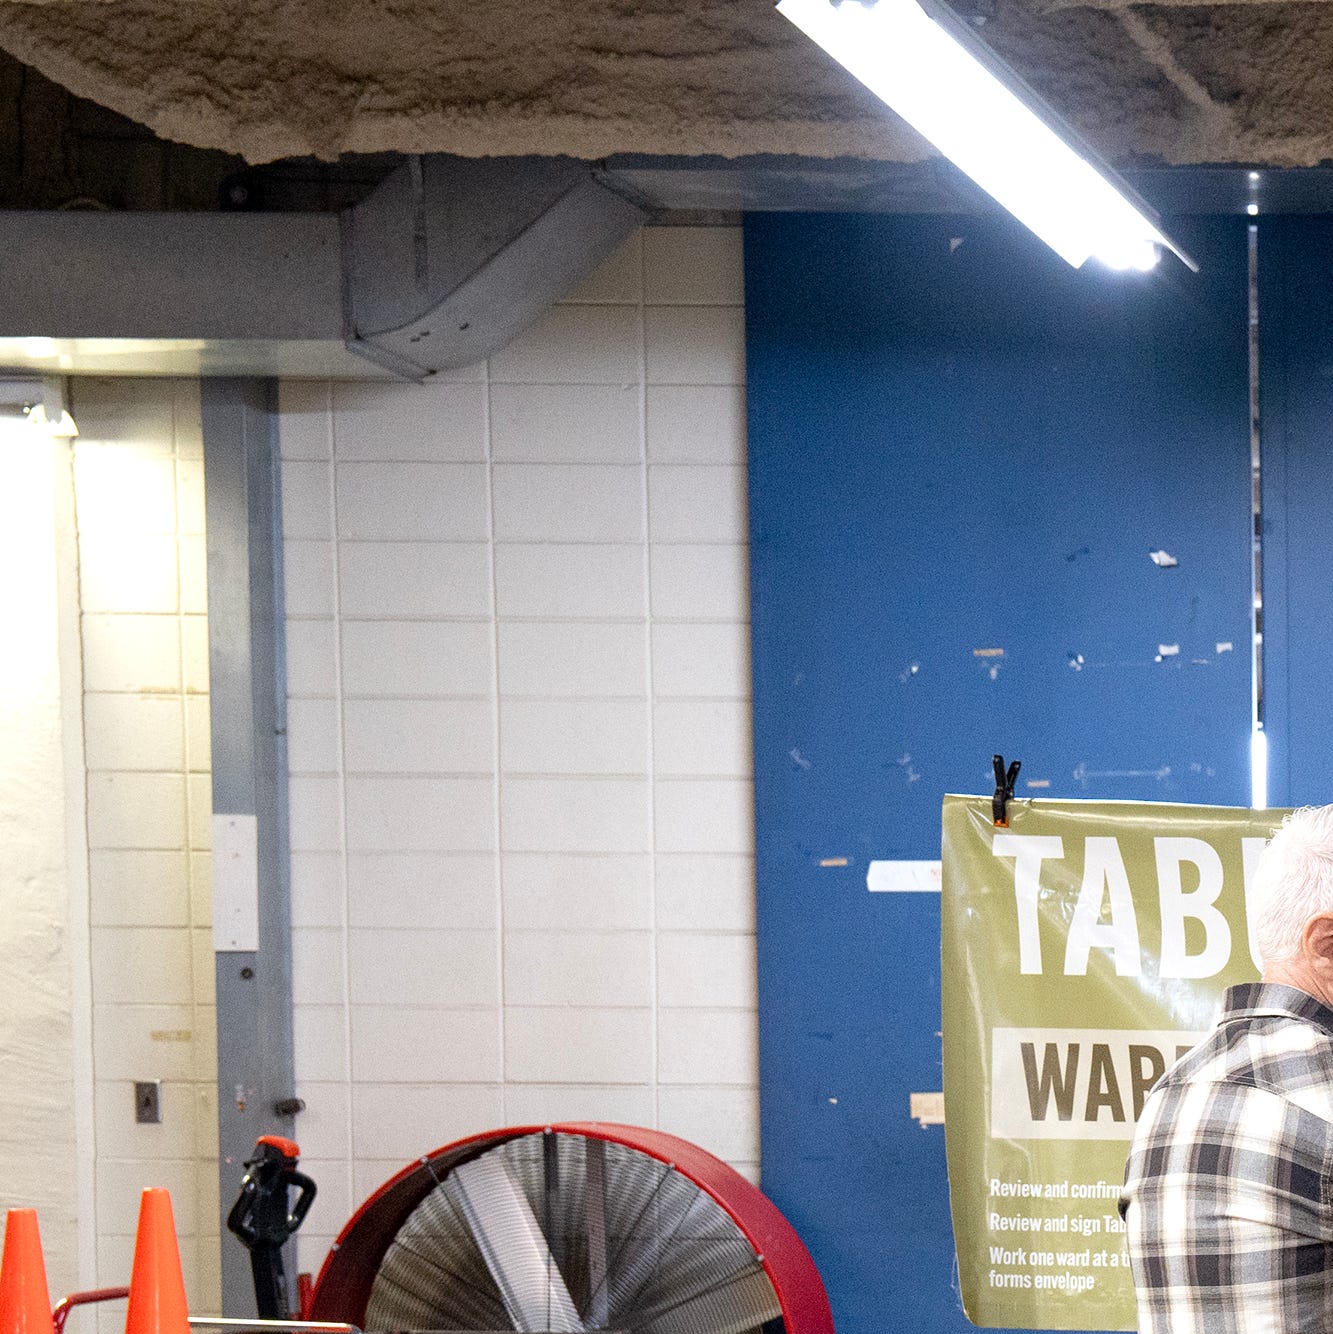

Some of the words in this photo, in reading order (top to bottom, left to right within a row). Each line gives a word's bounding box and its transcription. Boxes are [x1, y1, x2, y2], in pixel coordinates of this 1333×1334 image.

[990, 1179, 1042, 1197] Review
[1045, 1181, 1068, 1198] and
[989, 1213, 1042, 1232] Review
[1044, 1214, 1068, 1232] and
[1070, 1215, 1101, 1236] sign
[988, 1246, 1027, 1265] Work
[1029, 1252, 1055, 1266] one
[1056, 1249, 1090, 1267] ward
[1092, 1250, 1108, 1267] at
[1110, 1254, 1119, 1267] a
[988, 1270, 1031, 1288] forms
[1034, 1272, 1095, 1293] envelope
